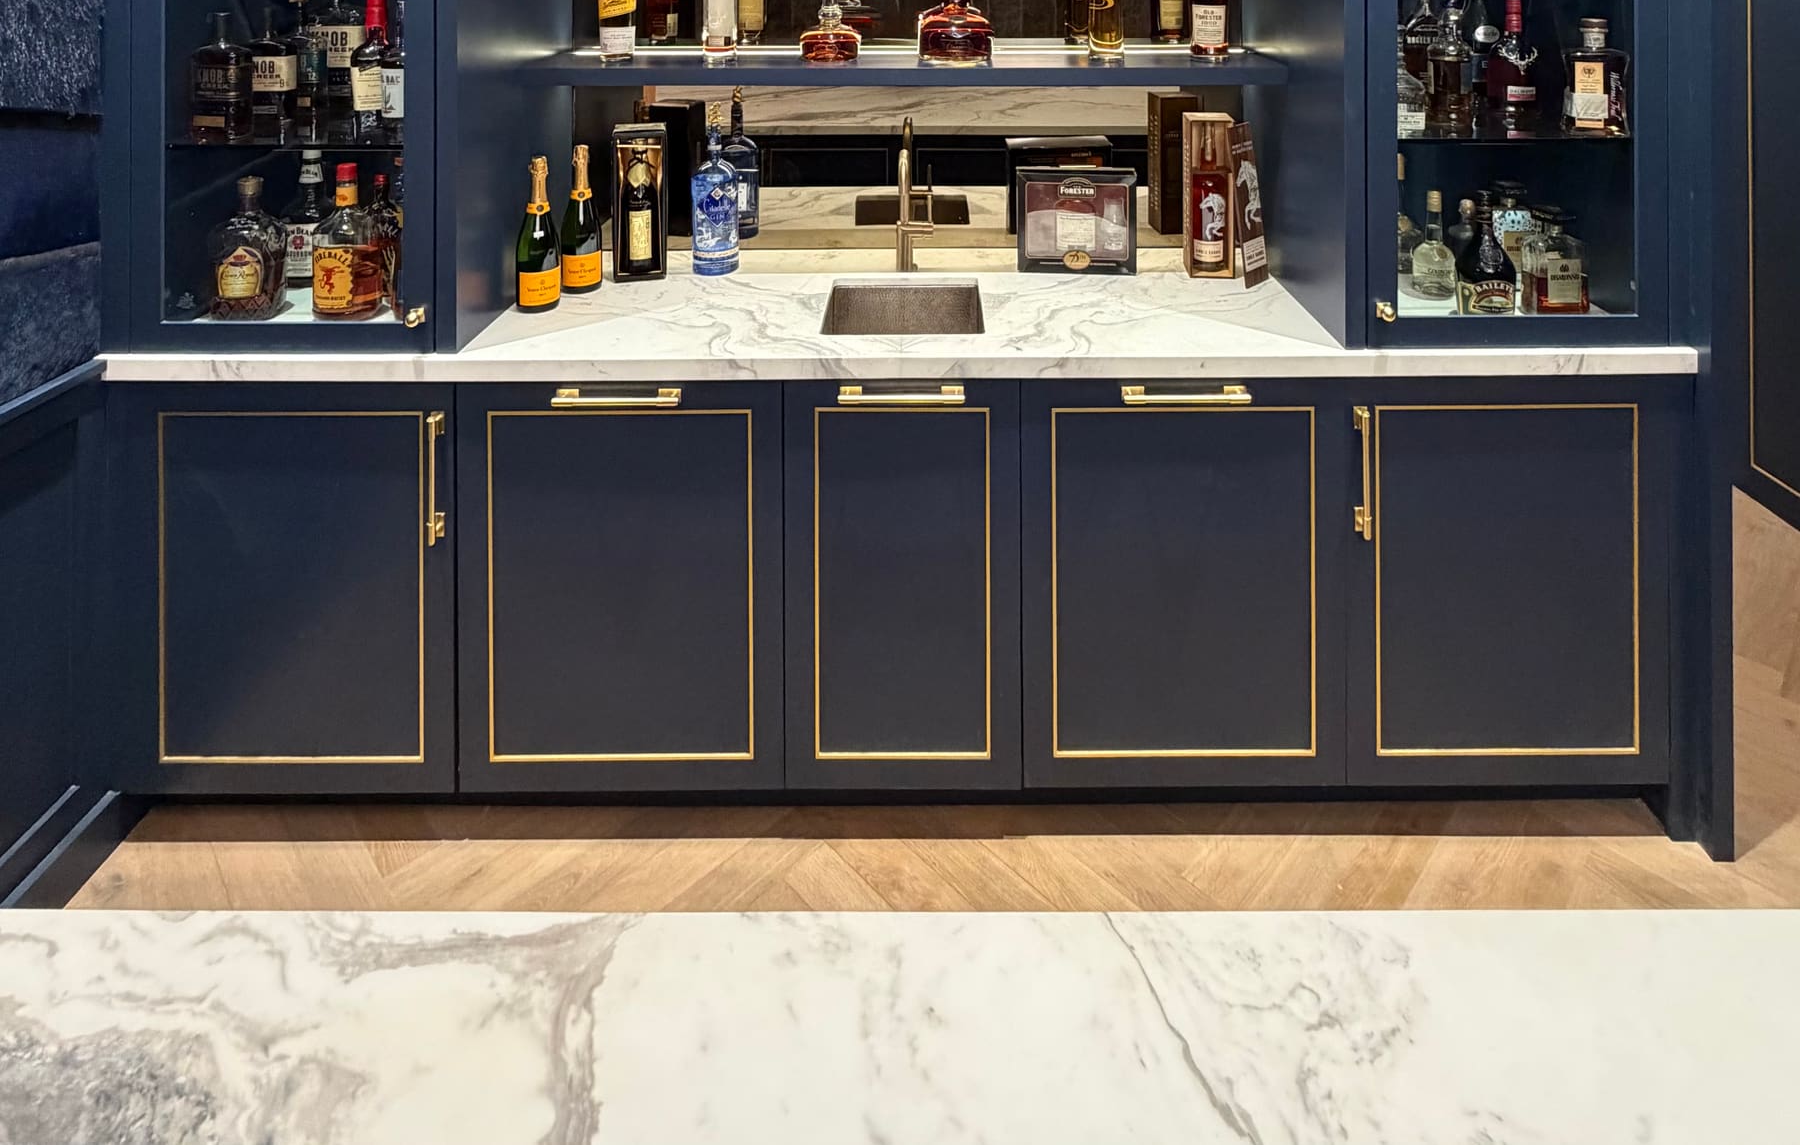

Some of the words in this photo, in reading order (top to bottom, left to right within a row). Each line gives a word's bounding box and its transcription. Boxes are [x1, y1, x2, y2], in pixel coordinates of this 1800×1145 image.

[253, 61, 275, 75] NOB
[1061, 186, 1094, 195] FORESTER
[315, 251, 349, 265] FIREBALL
[1475, 282, 1513, 294] BAILEYS
